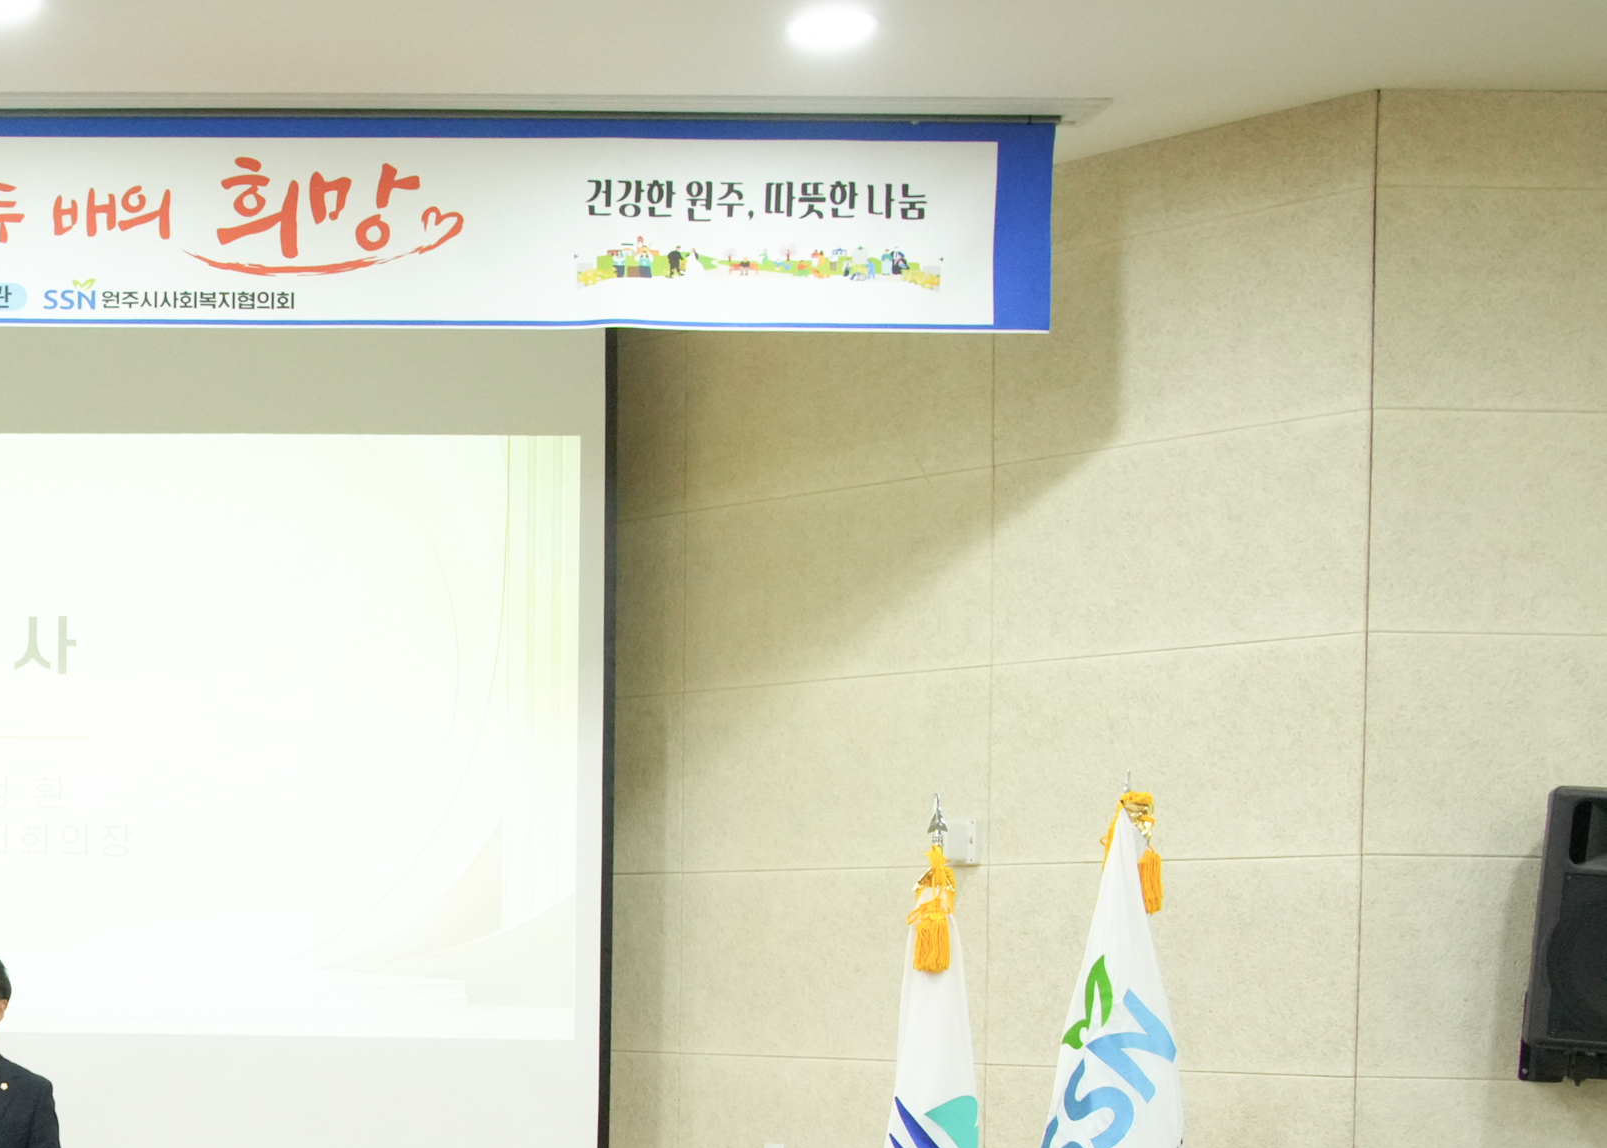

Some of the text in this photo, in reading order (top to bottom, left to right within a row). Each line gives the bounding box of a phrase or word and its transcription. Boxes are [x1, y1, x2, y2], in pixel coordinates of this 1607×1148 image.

[53, 185, 172, 240] 배의
[216, 157, 421, 259] 희망
[586, 179, 928, 222] 건강한 원주, 따뜻한 나눔
[43, 288, 295, 310] SSN 원주시사회복지협의회
